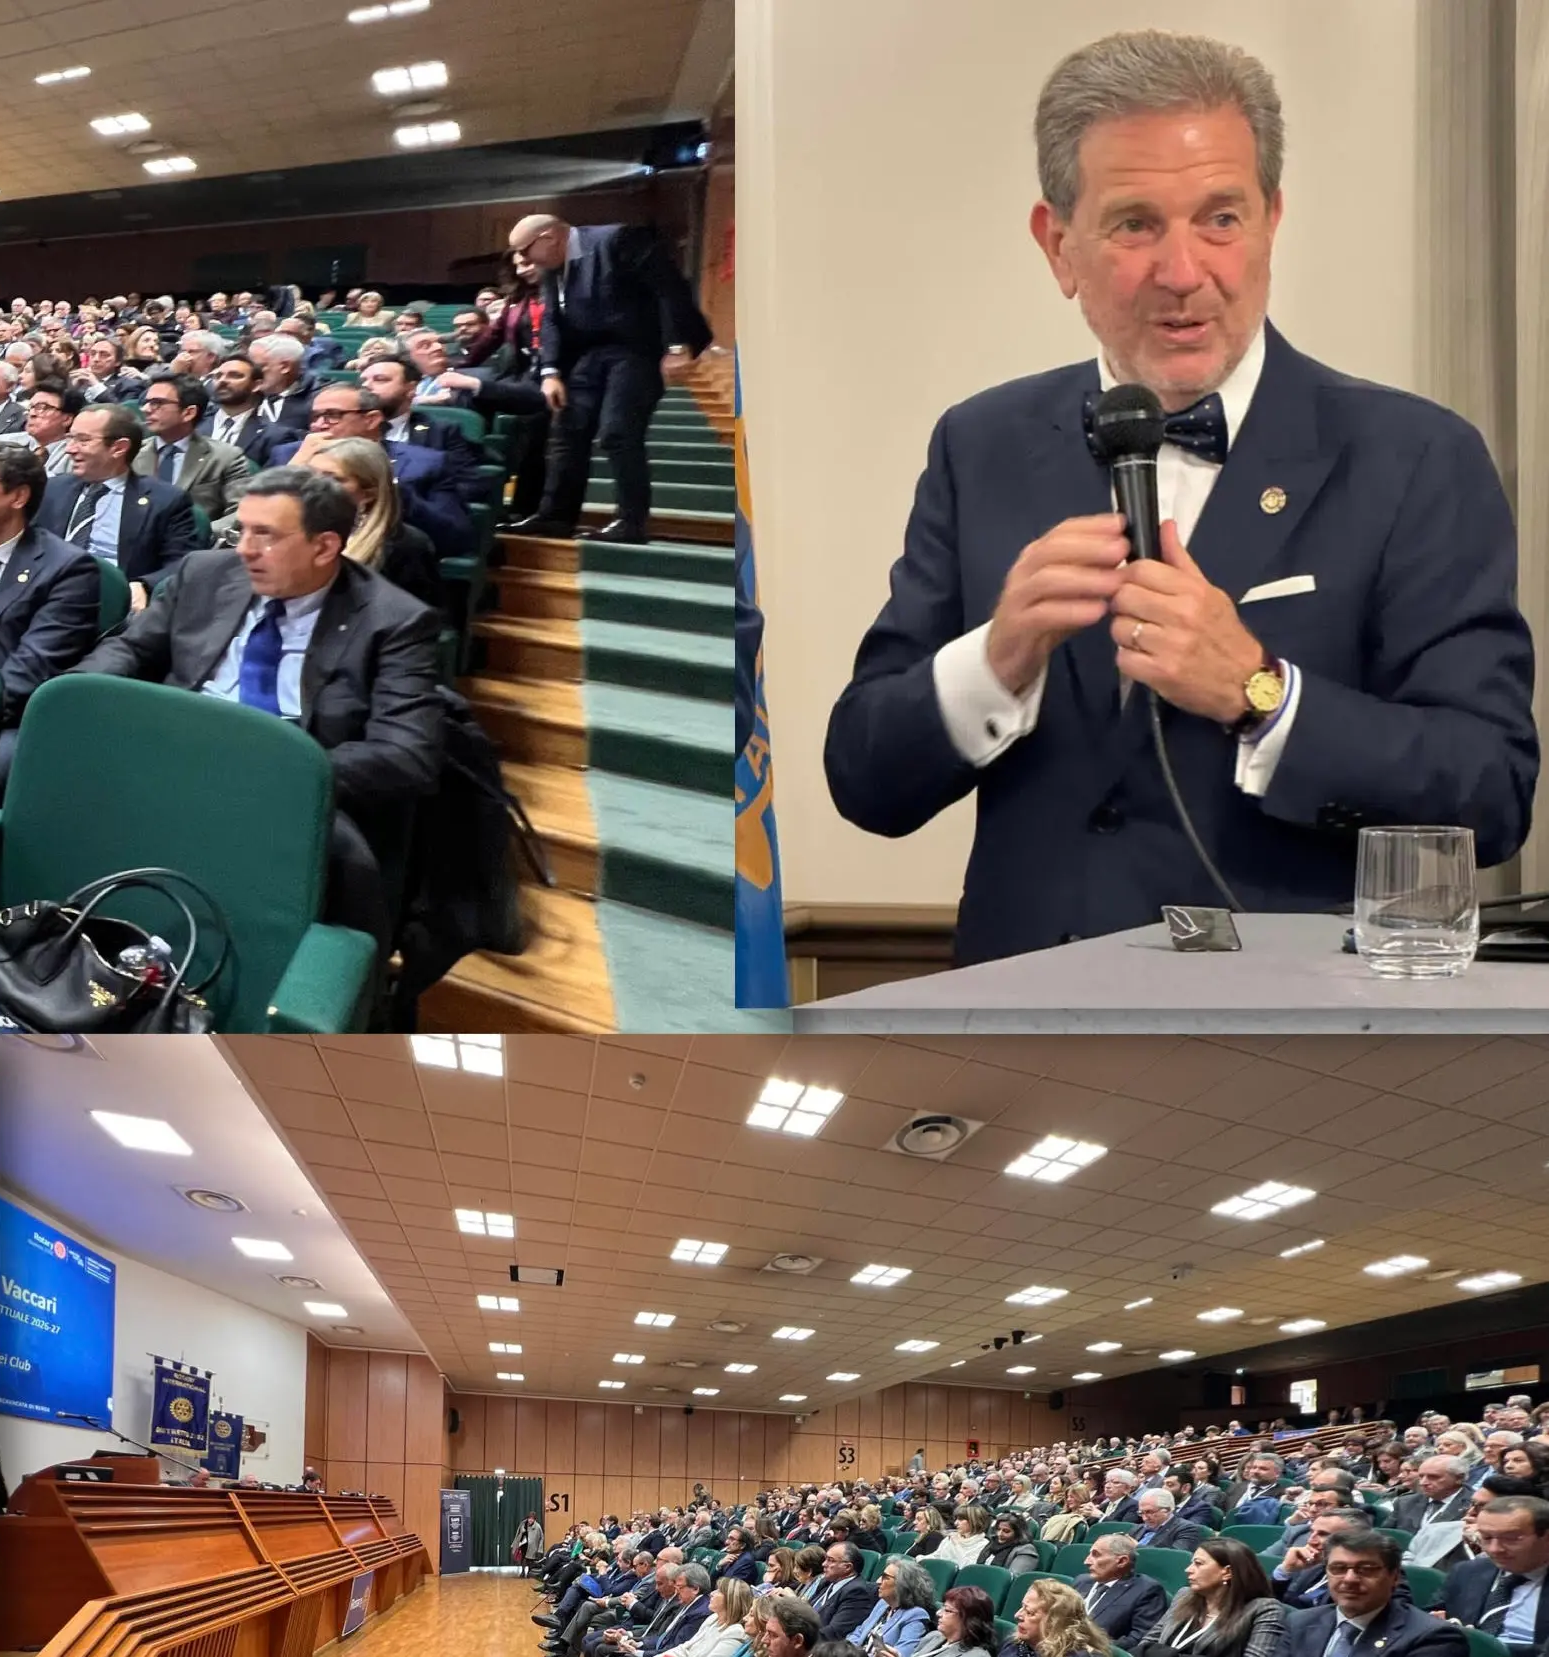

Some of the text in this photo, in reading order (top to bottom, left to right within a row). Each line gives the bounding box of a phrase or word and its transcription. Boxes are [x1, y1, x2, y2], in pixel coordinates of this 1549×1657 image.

[33, 1232, 54, 1250] Rotary
[1, 1275, 58, 1315] Vaccari
[29, 1316, 61, 1335] 2026-27
[9, 1356, 32, 1371] Club
[838, 1447, 855, 1464] S3
[550, 1493, 569, 1512] S1
